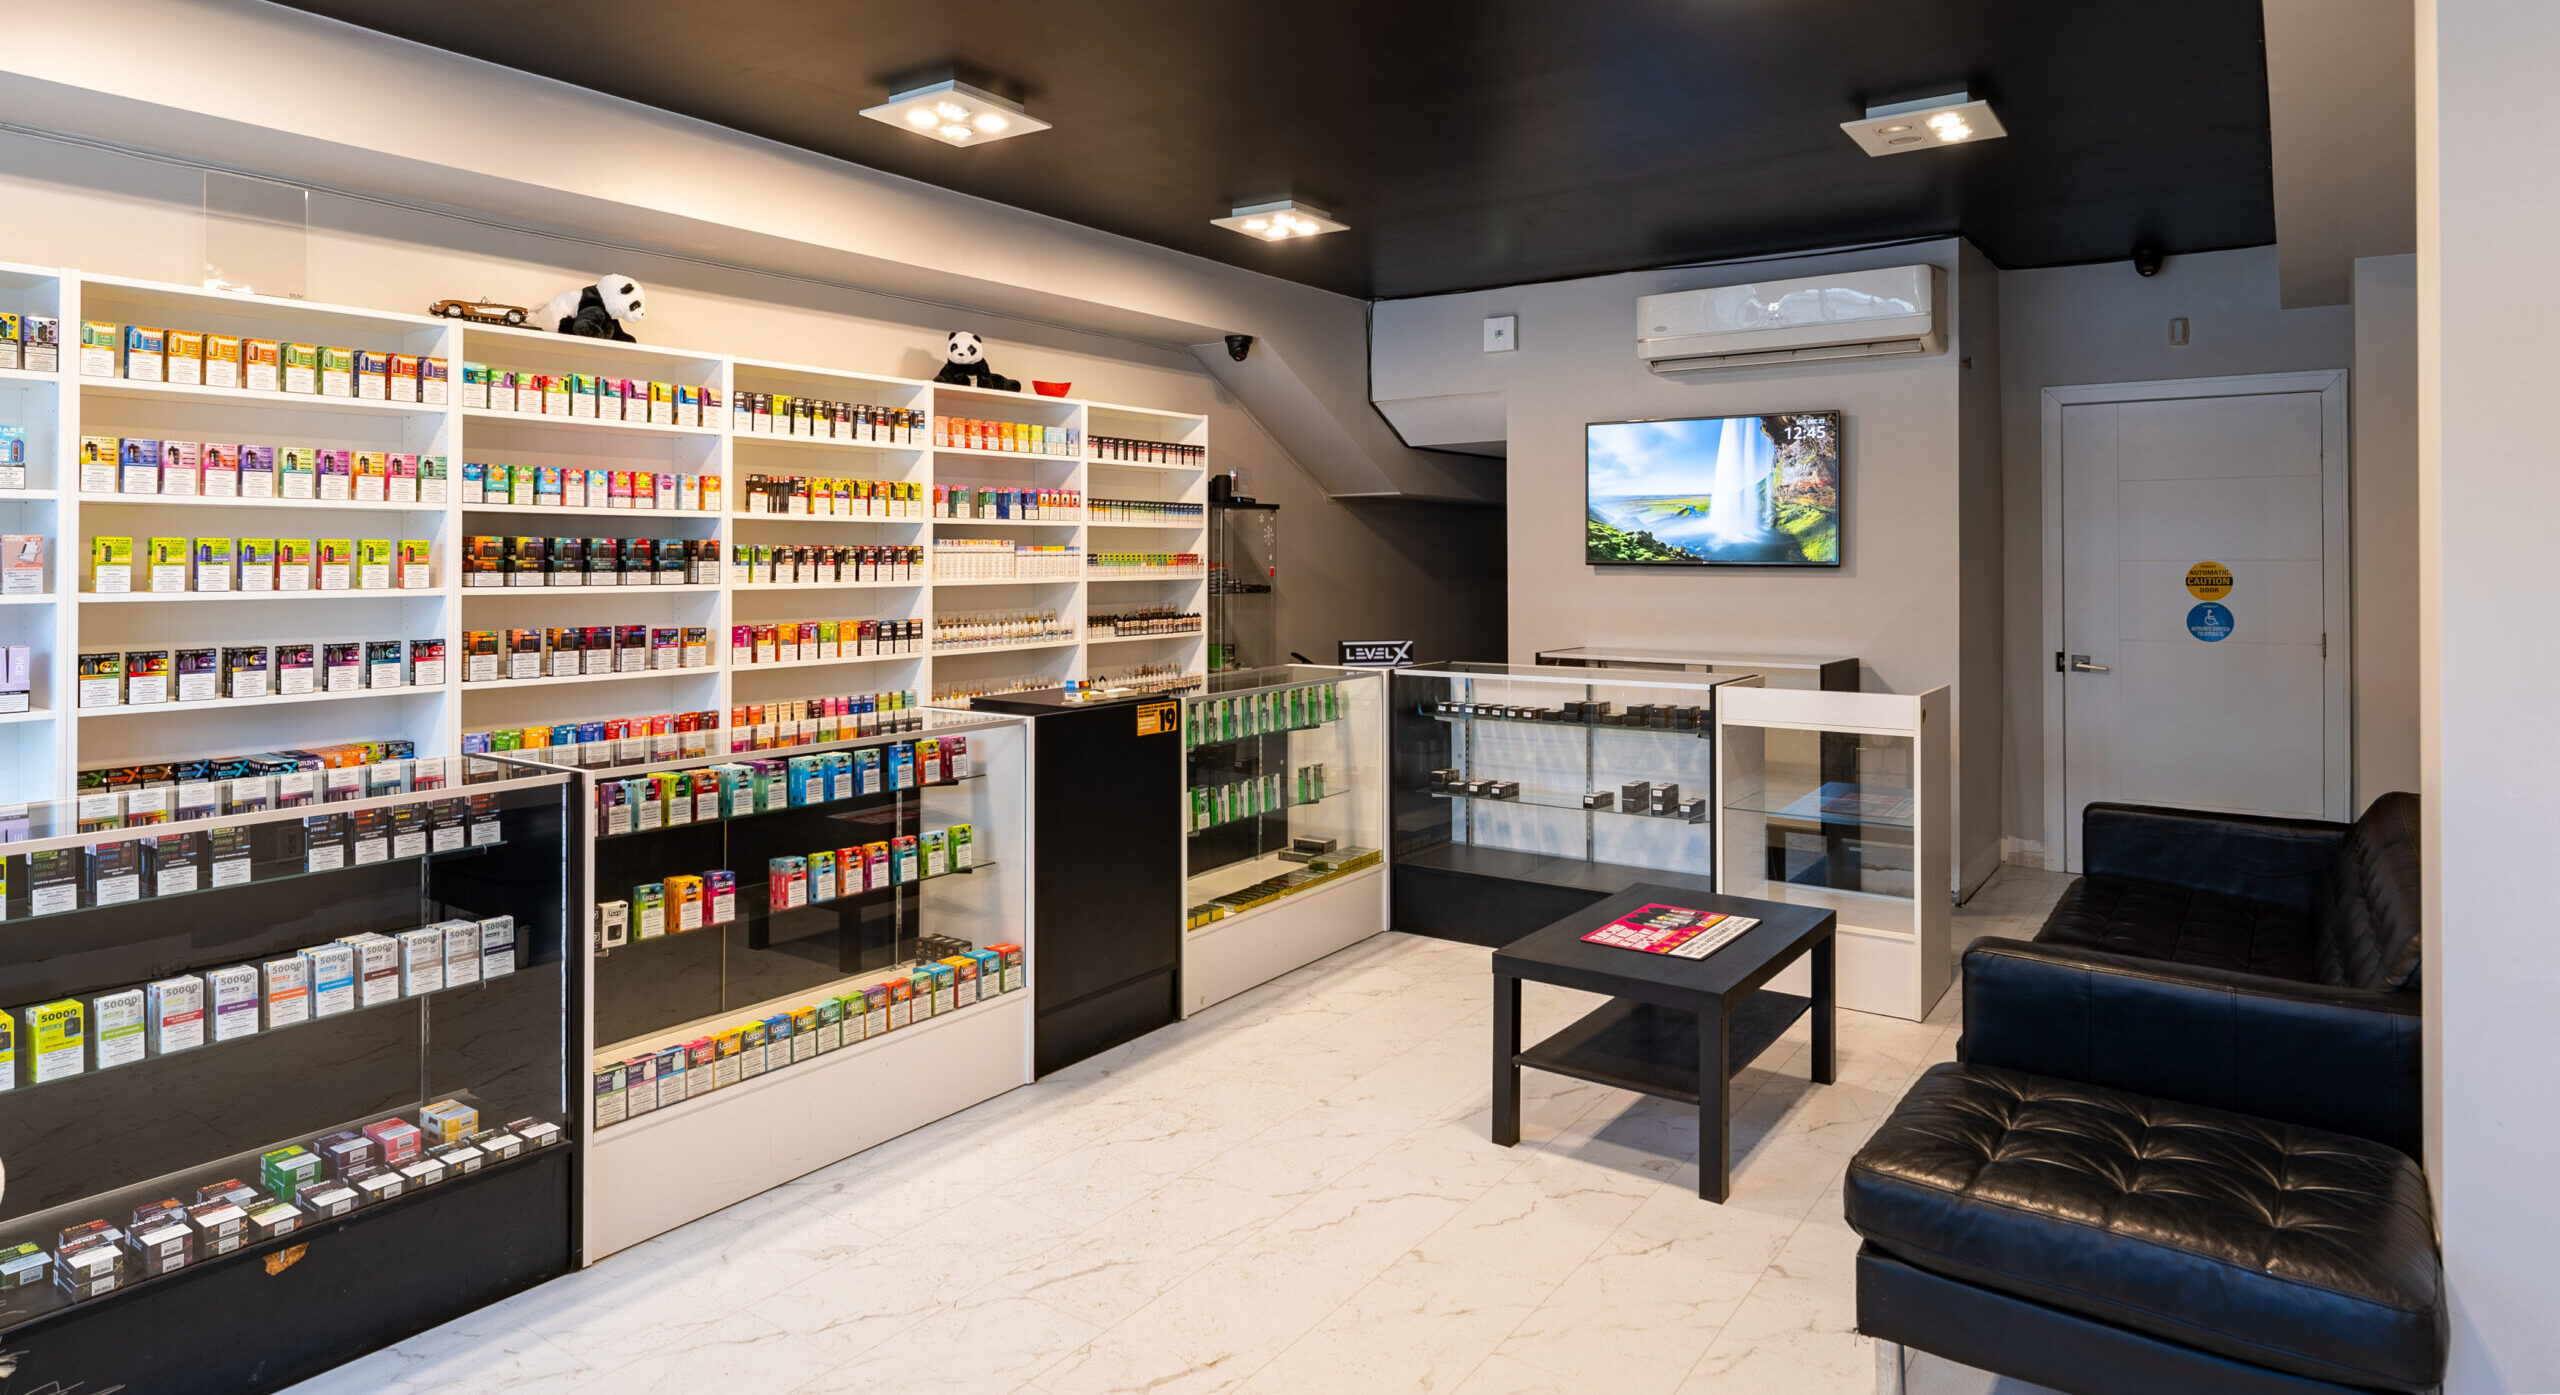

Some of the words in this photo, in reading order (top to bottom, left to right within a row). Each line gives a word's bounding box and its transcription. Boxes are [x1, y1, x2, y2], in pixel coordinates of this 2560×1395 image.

[1784, 426, 1826, 440] 12:45
[2187, 577, 2230, 585] CAUTION
[16, 656, 24, 676] VICE
[1159, 708, 1176, 731] 19
[450, 928, 475, 938] 50000
[412, 936, 438, 946] 50000
[367, 943, 393, 954] 50000
[320, 952, 348, 965] 50000
[272, 961, 302, 974] 50000
[220, 973, 252, 986] 50000
[166, 983, 198, 997] 50000
[103, 997, 138, 1011] 50000
[41, 1008, 77, 1023] 50000
